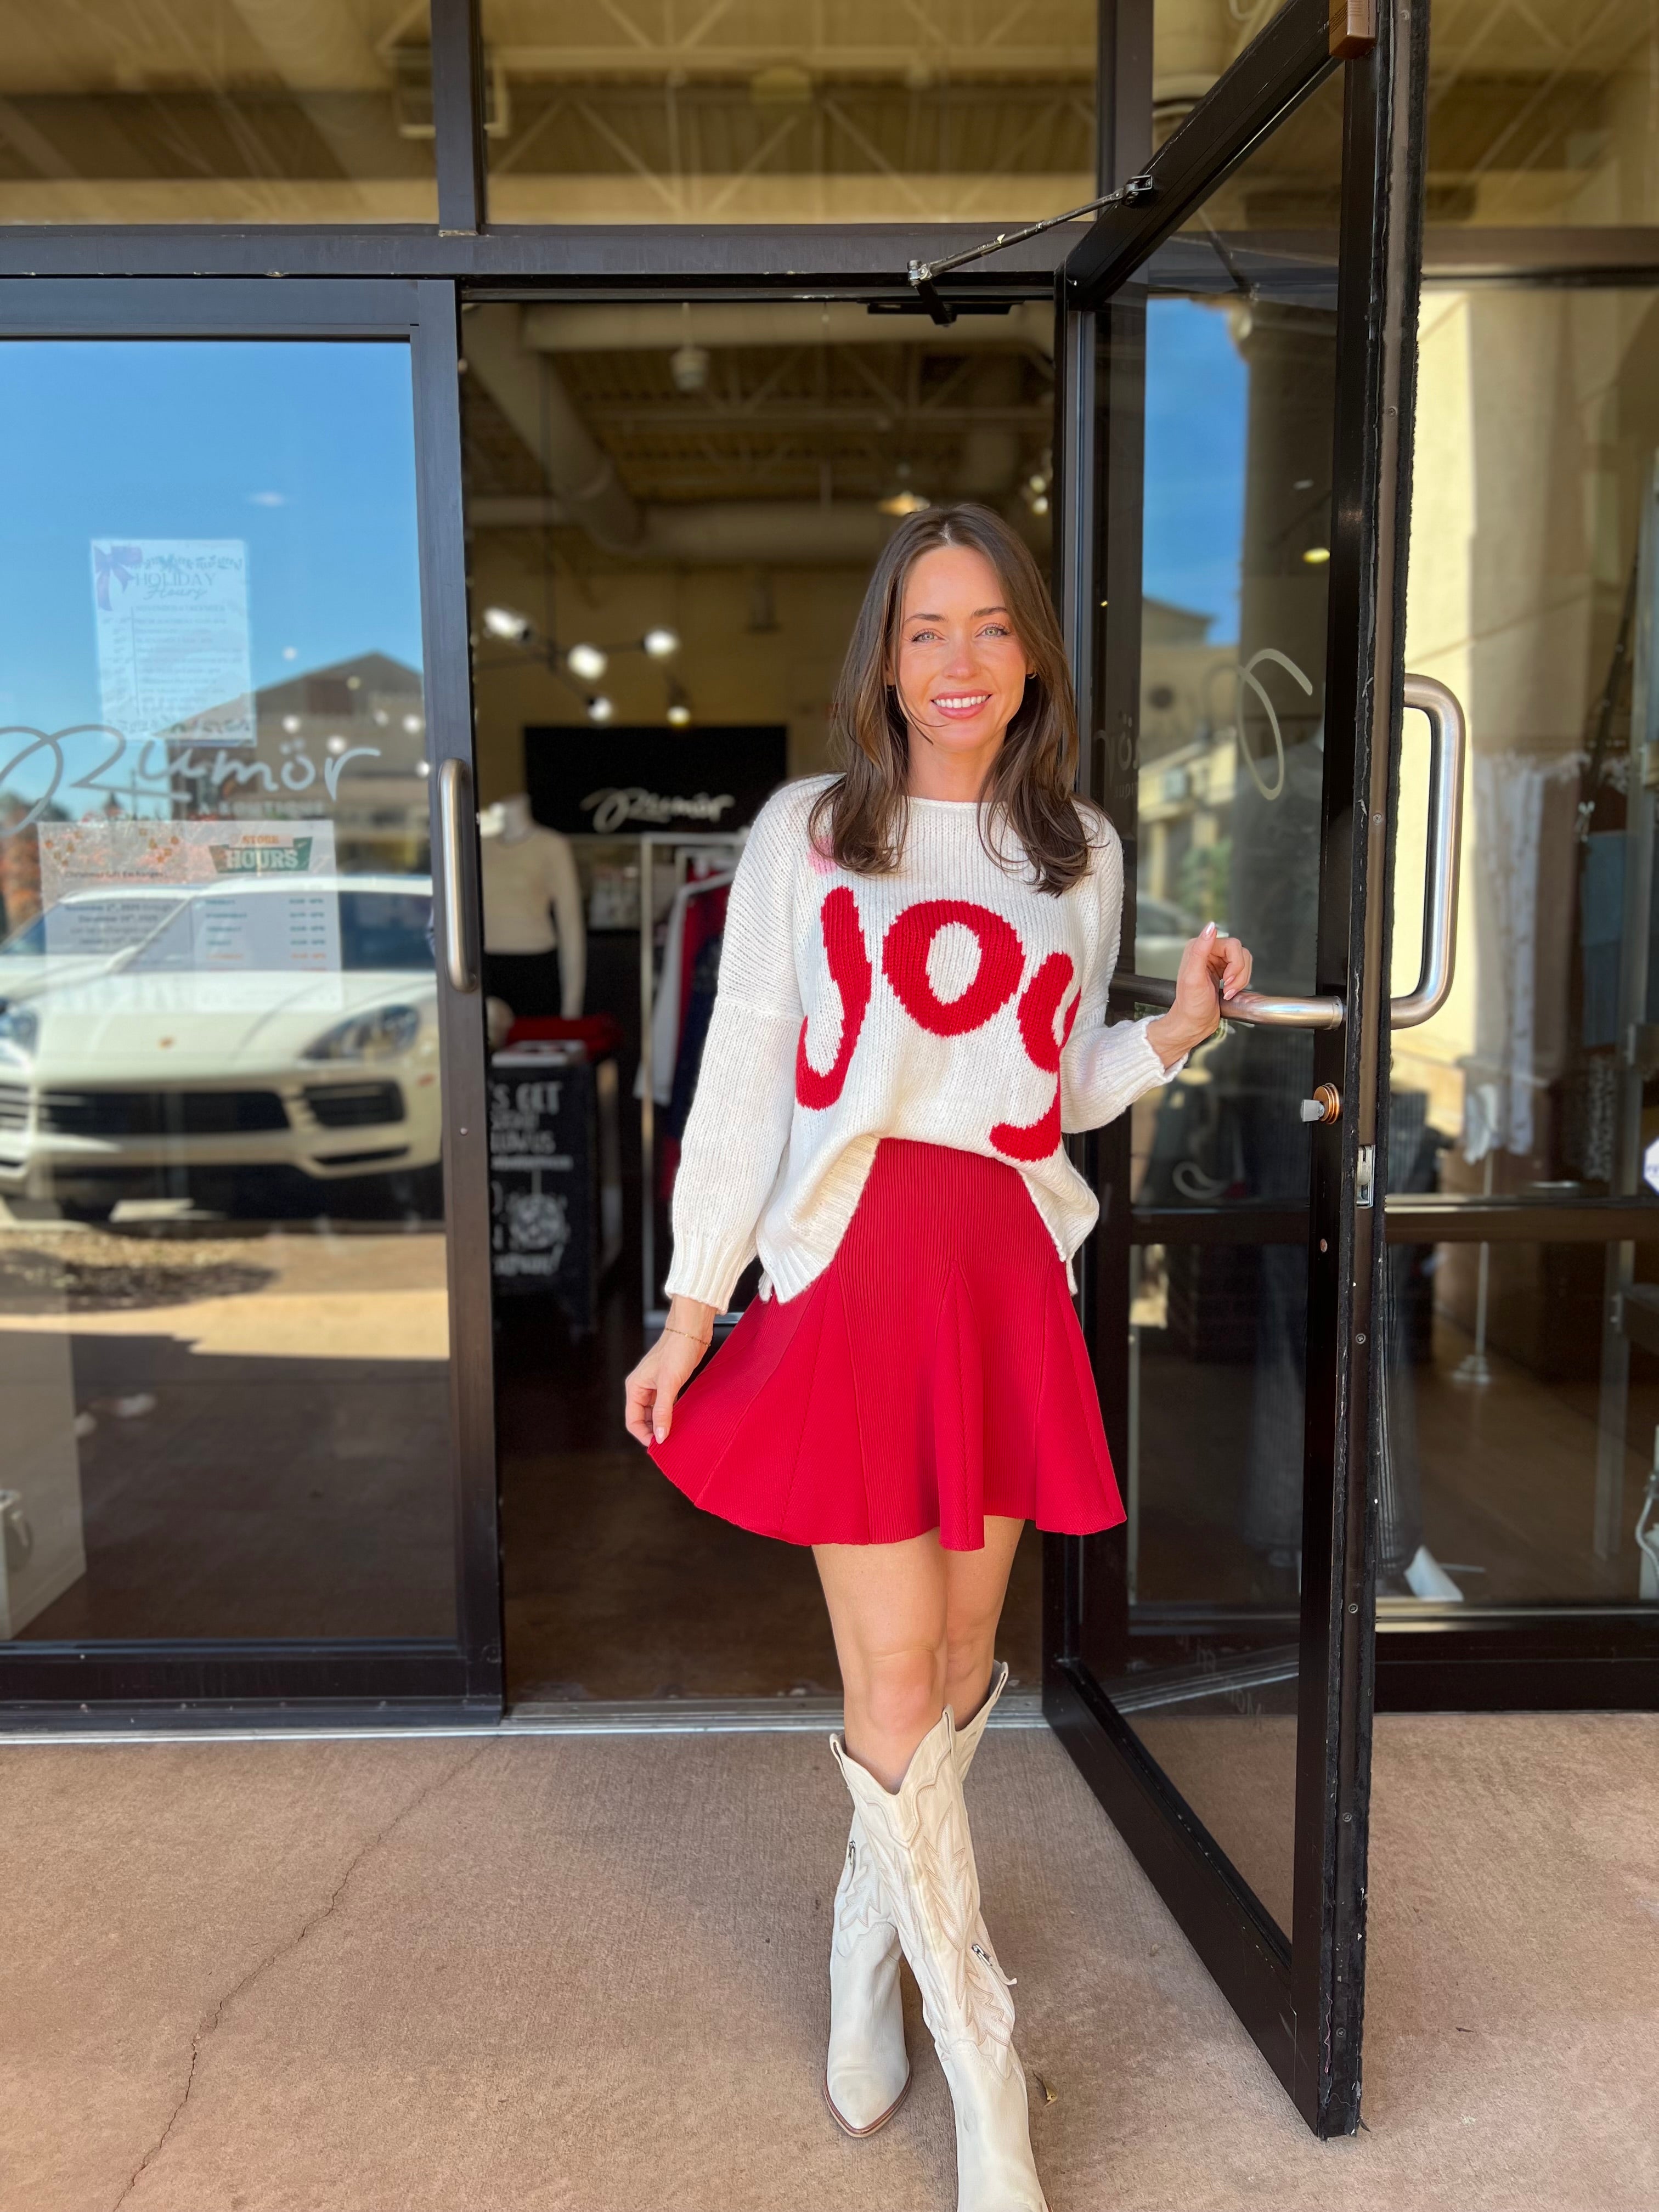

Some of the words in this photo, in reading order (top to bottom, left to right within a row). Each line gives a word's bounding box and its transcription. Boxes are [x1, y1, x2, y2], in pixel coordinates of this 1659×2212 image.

[136, 573, 216, 586] HOLIDAY
[242, 834, 279, 844] STORE
[225, 849, 298, 868] HOURS
